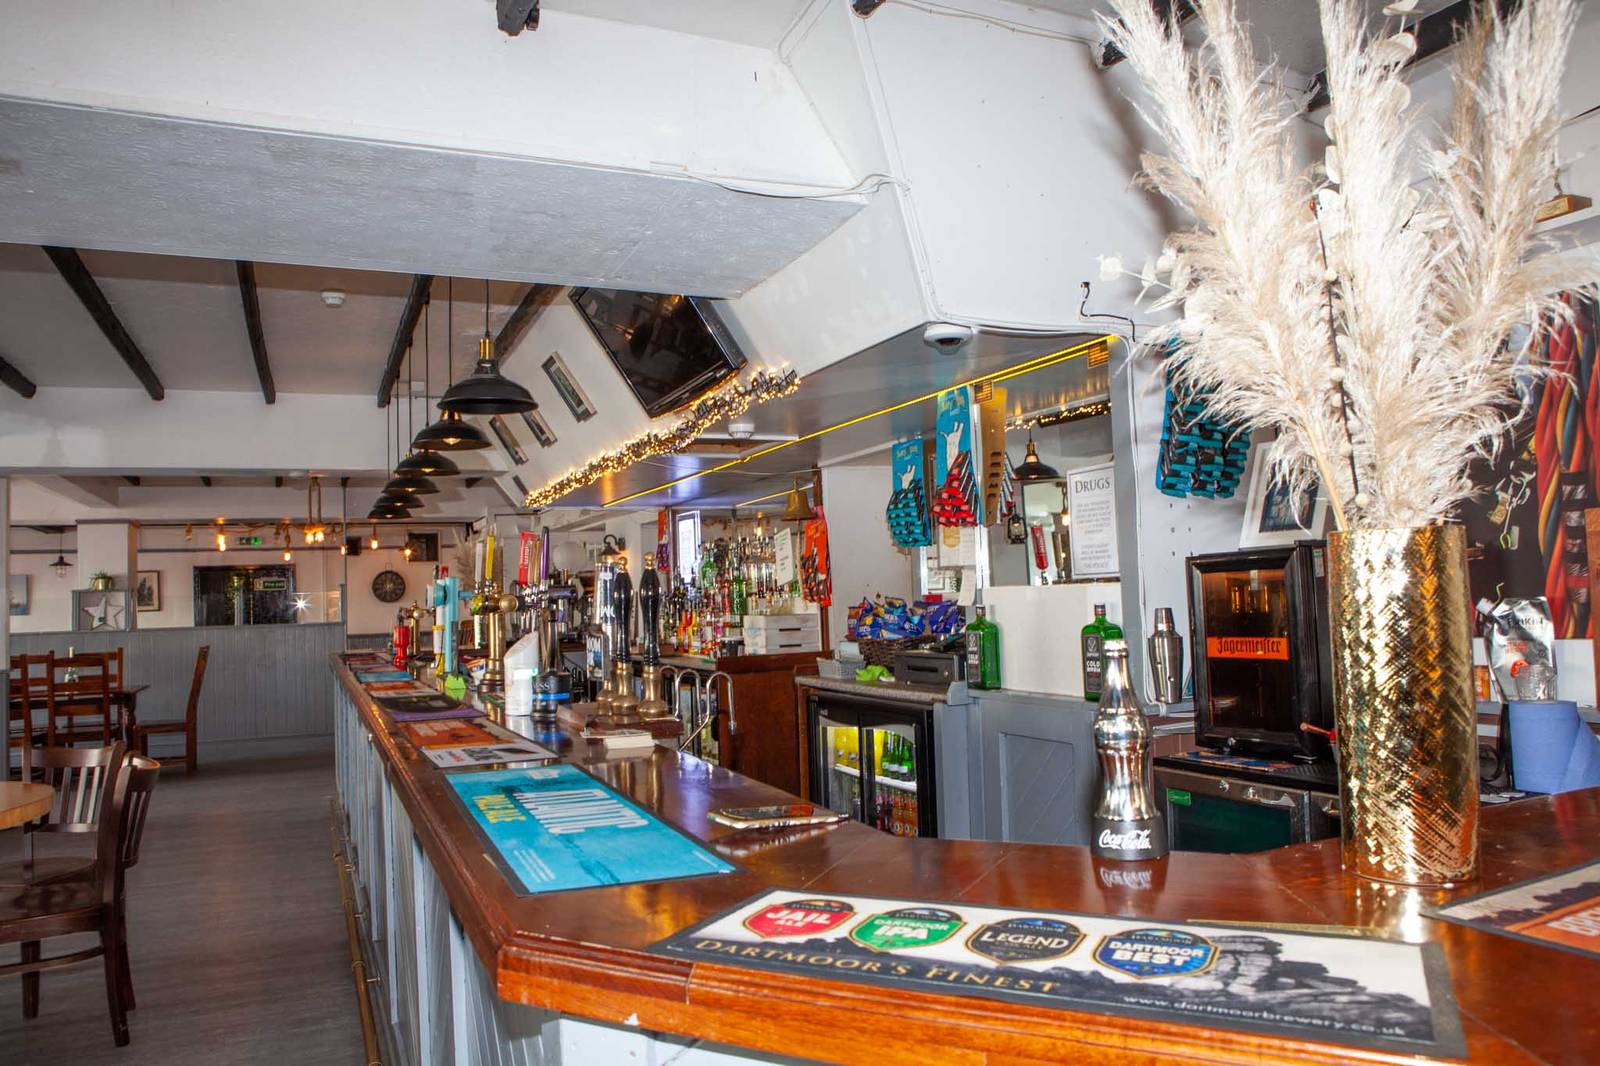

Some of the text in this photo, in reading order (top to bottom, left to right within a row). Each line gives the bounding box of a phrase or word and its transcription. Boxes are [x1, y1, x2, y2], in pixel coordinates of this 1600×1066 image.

[1074, 478, 1111, 494] DRUGS
[1099, 829, 1152, 849] Coca-Cola
[766, 911, 831, 925] JAIL
[873, 925, 929, 940] IPA
[981, 931, 1069, 949] LEGEND
[1108, 941, 1204, 957] DARTMOOR
[695, 939, 1060, 992] DARTMOOR'S FINEST
[1112, 950, 1190, 966] BEST
[1122, 995, 1406, 1036] www.dartmoorbrewery.co.uk
